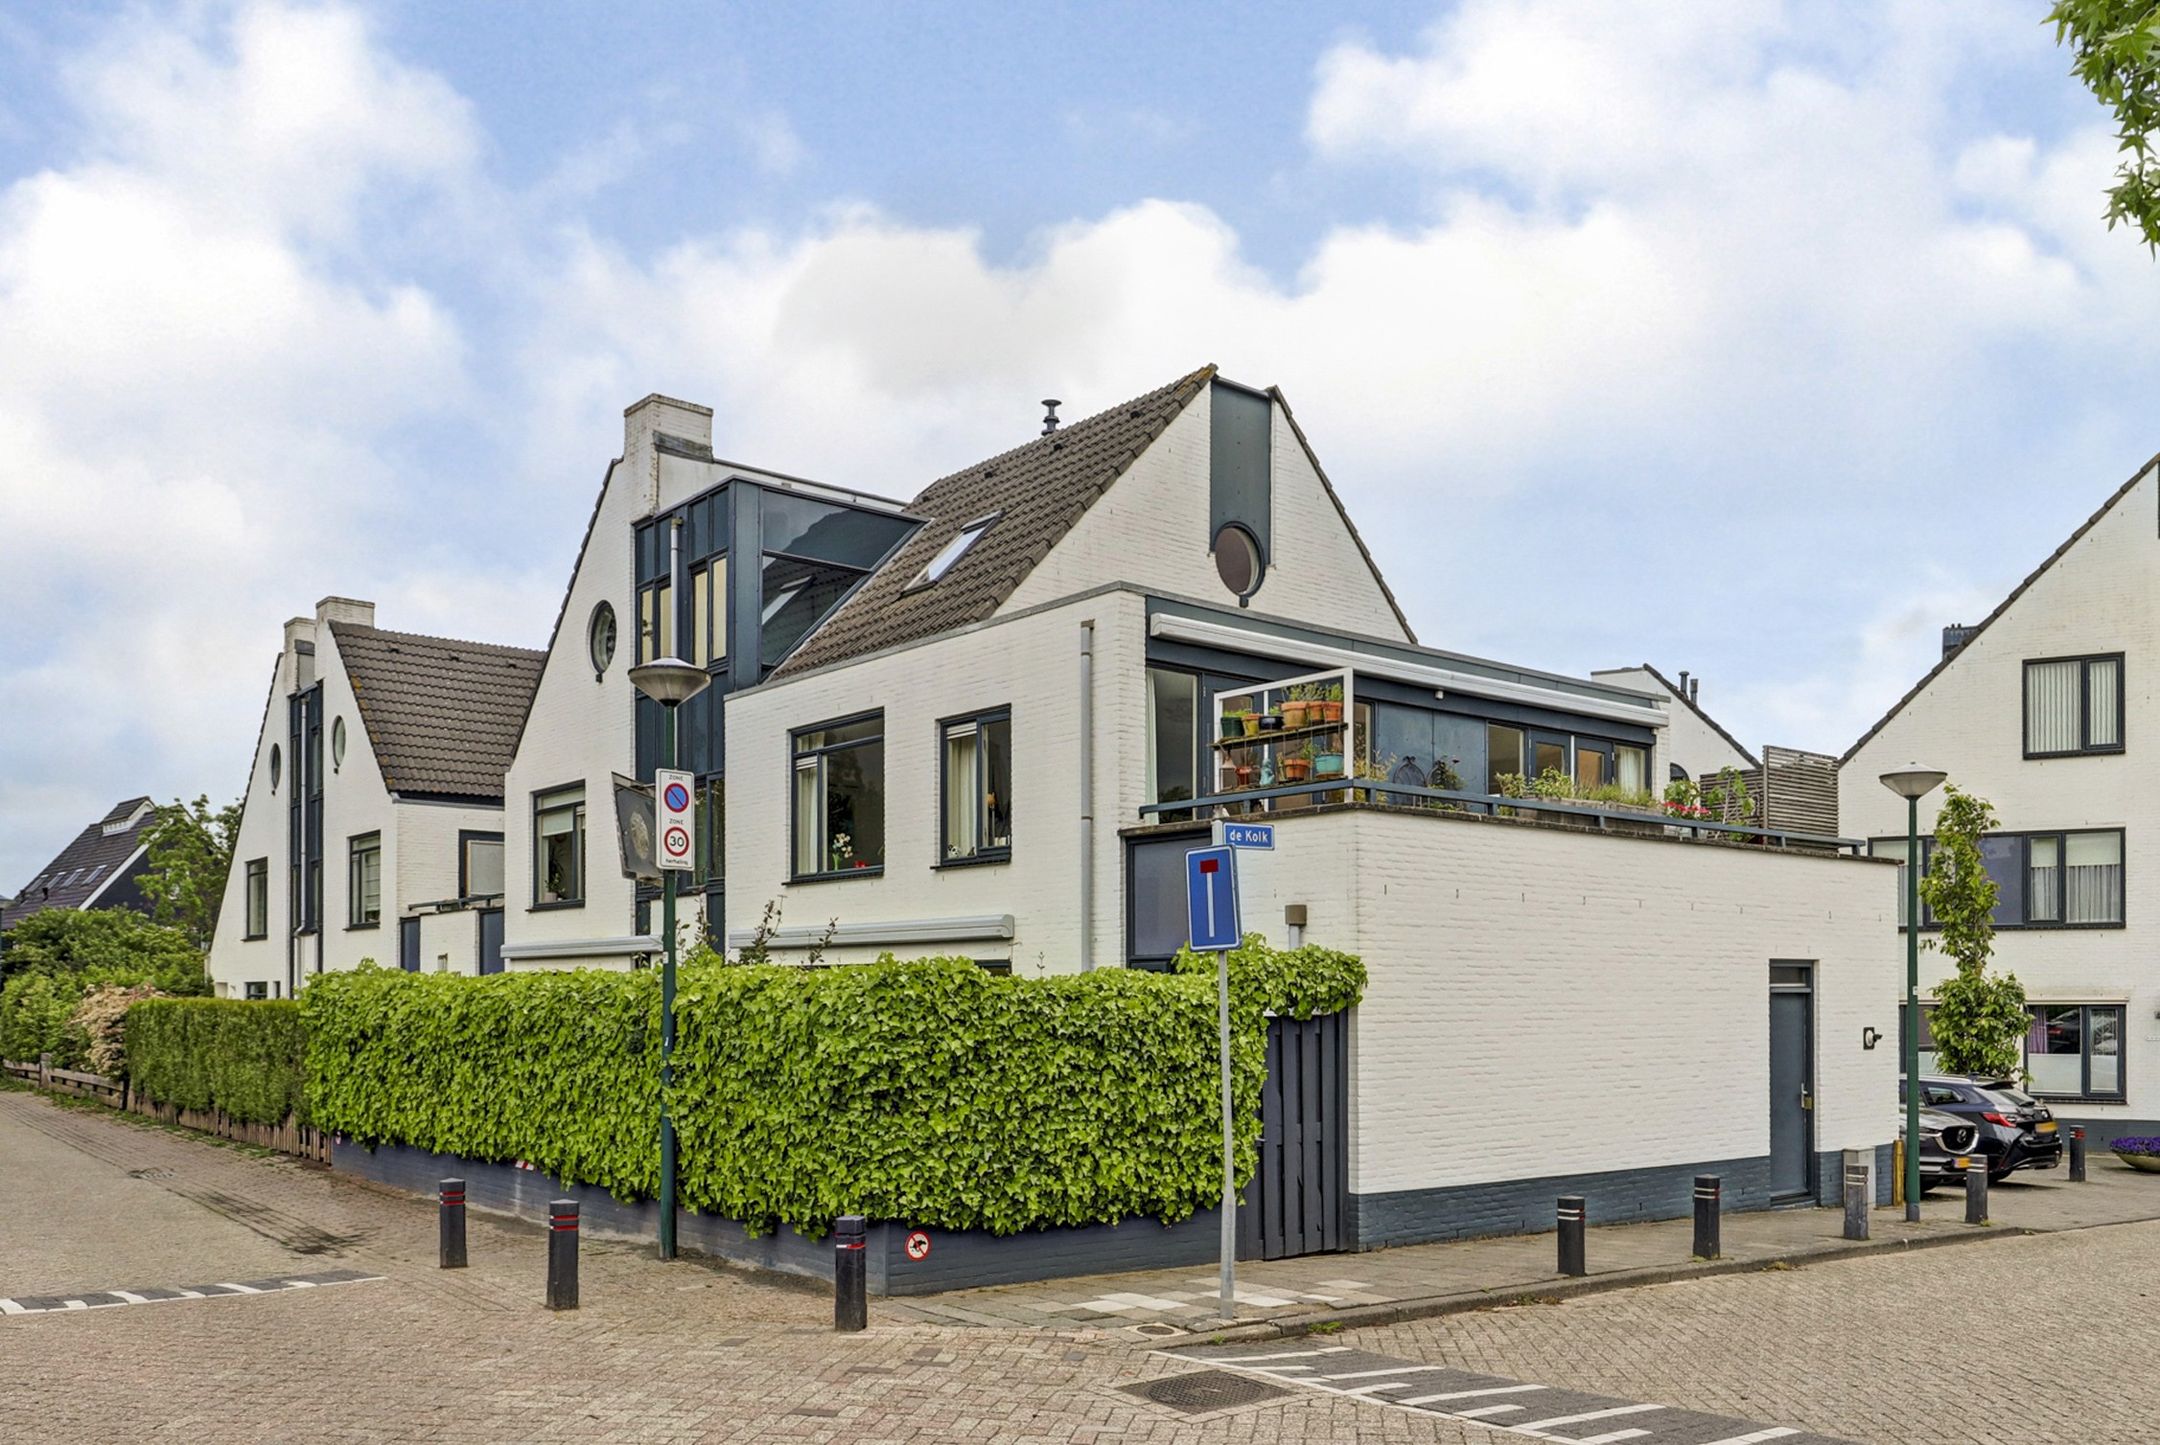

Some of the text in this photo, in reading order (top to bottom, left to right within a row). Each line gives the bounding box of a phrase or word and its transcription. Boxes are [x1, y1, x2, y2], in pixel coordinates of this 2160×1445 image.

[669, 836, 684, 847] 30
[1230, 829, 1268, 843] de Kolk
